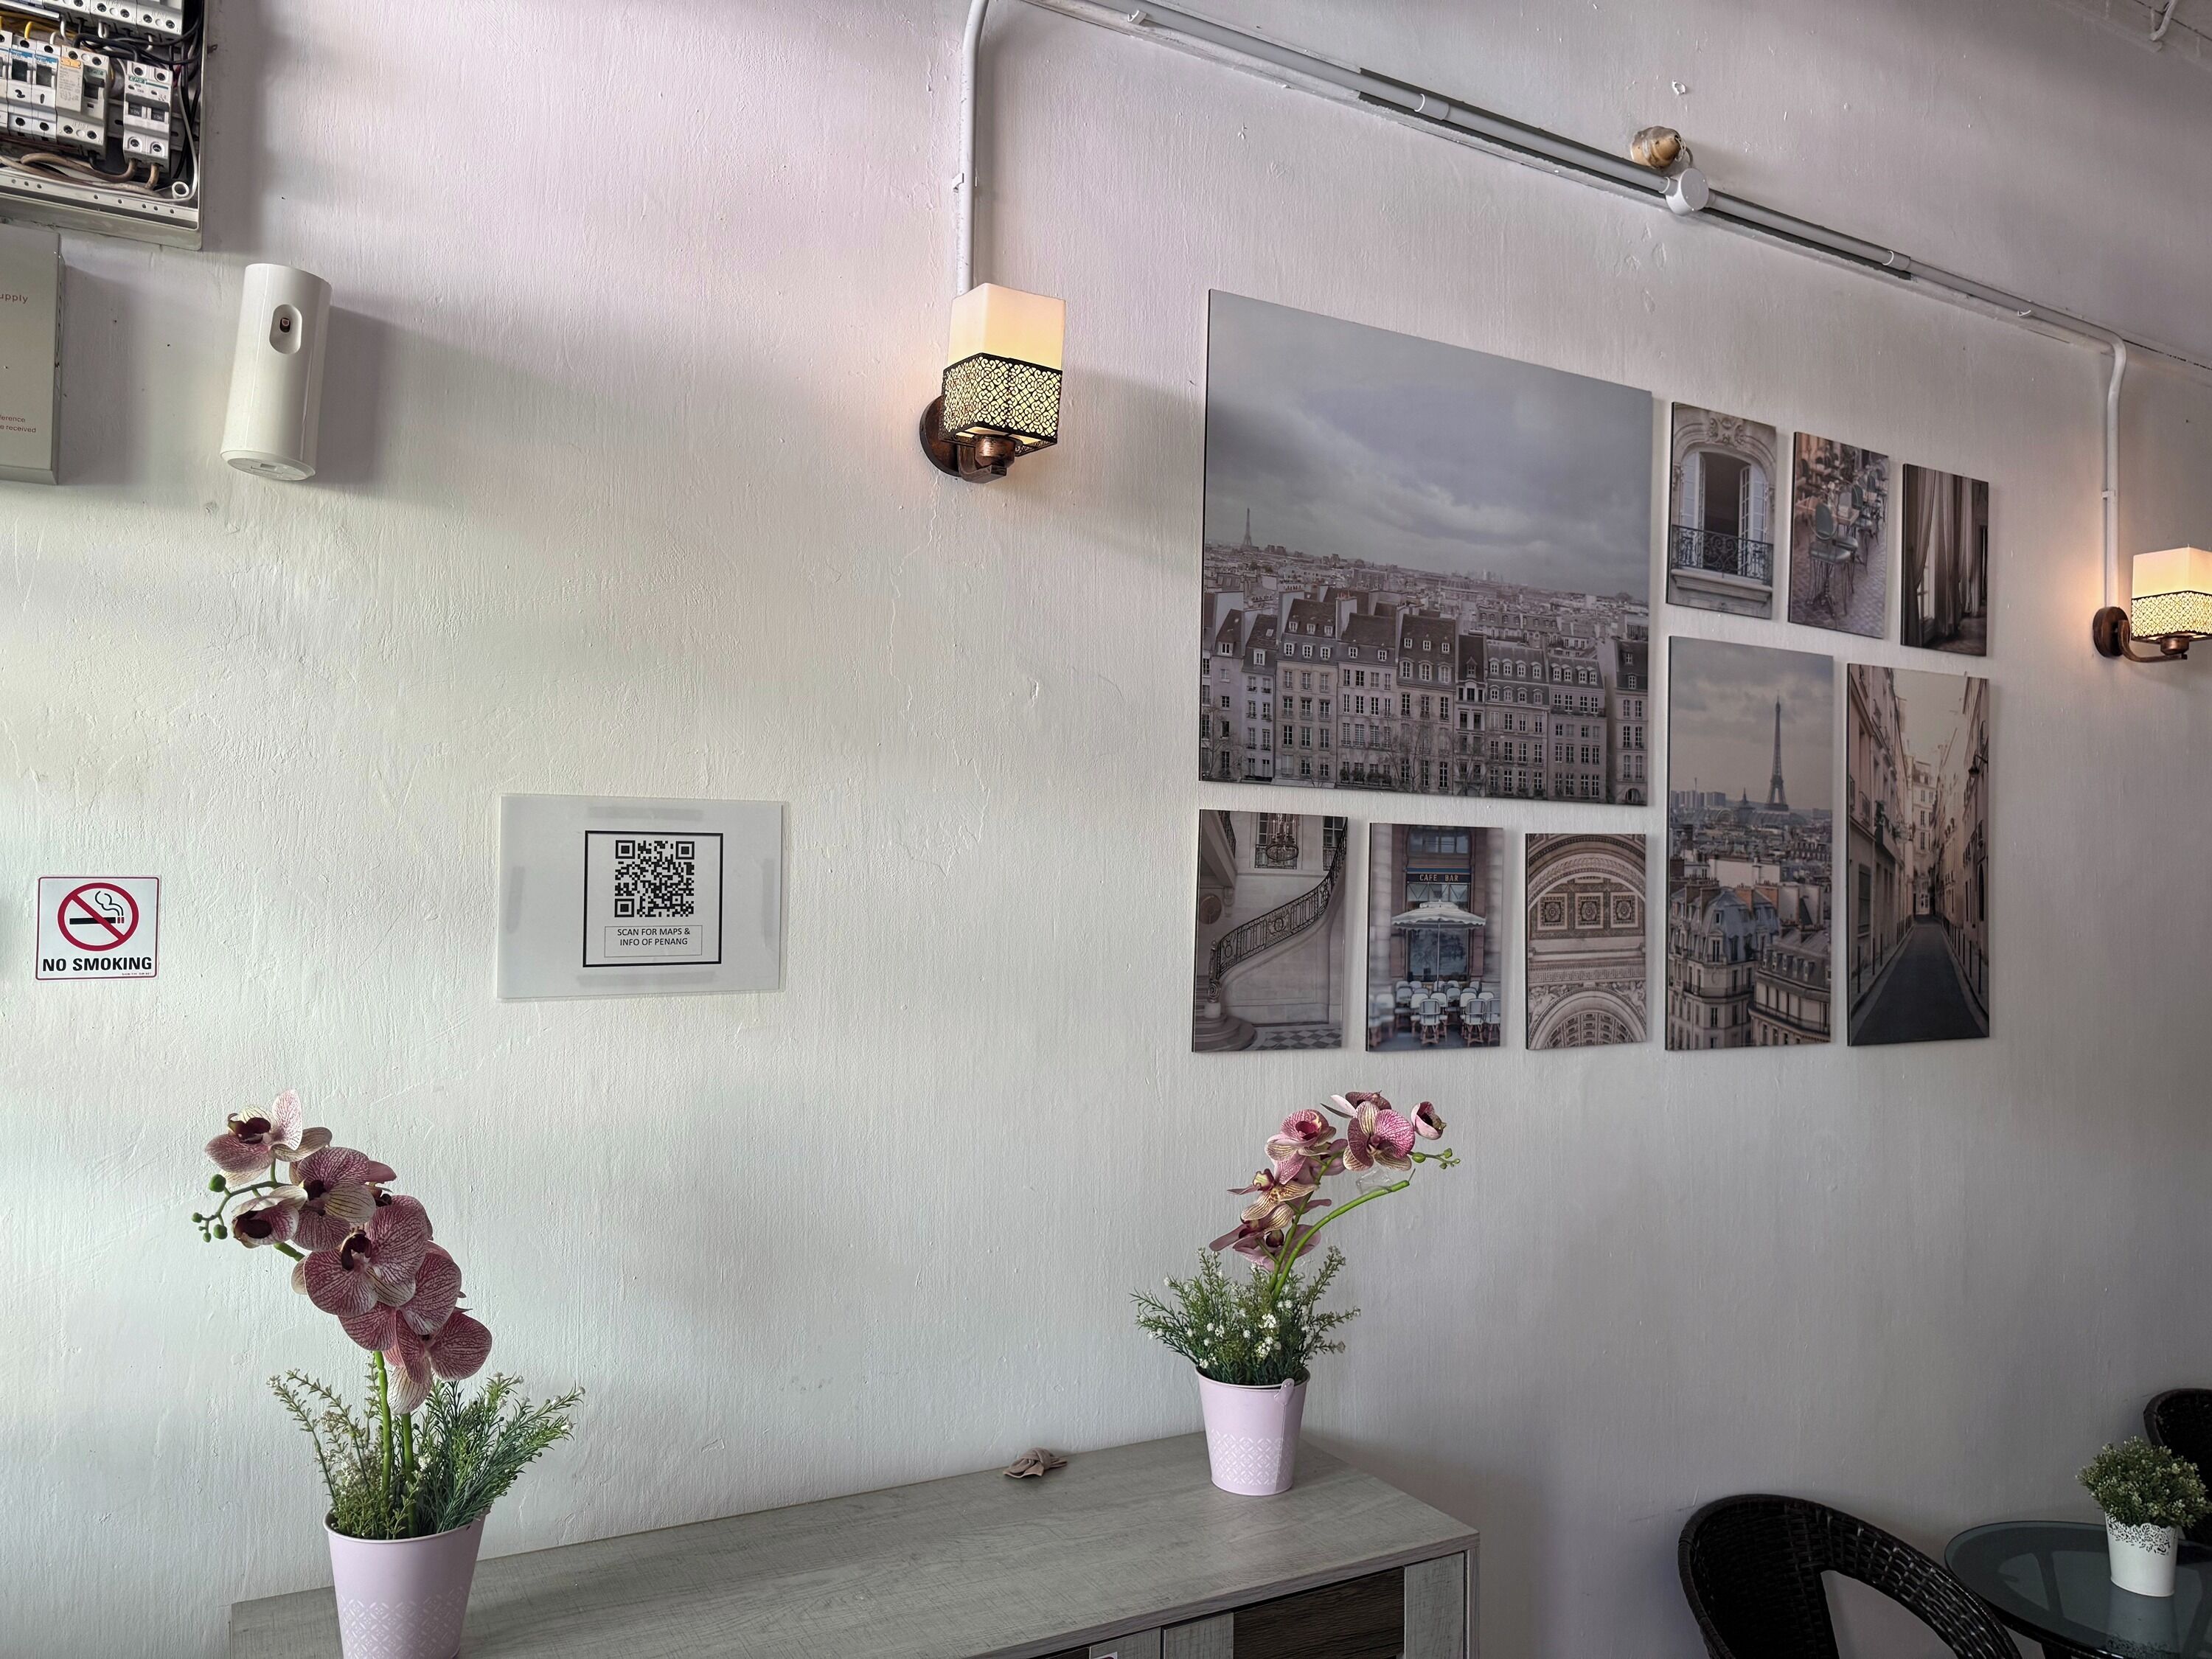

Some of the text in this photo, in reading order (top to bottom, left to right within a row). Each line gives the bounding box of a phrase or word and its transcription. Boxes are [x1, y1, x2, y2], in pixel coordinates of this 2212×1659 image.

[655, 937, 688, 945] PENANG
[42, 956, 152, 972] NO SMOKING
